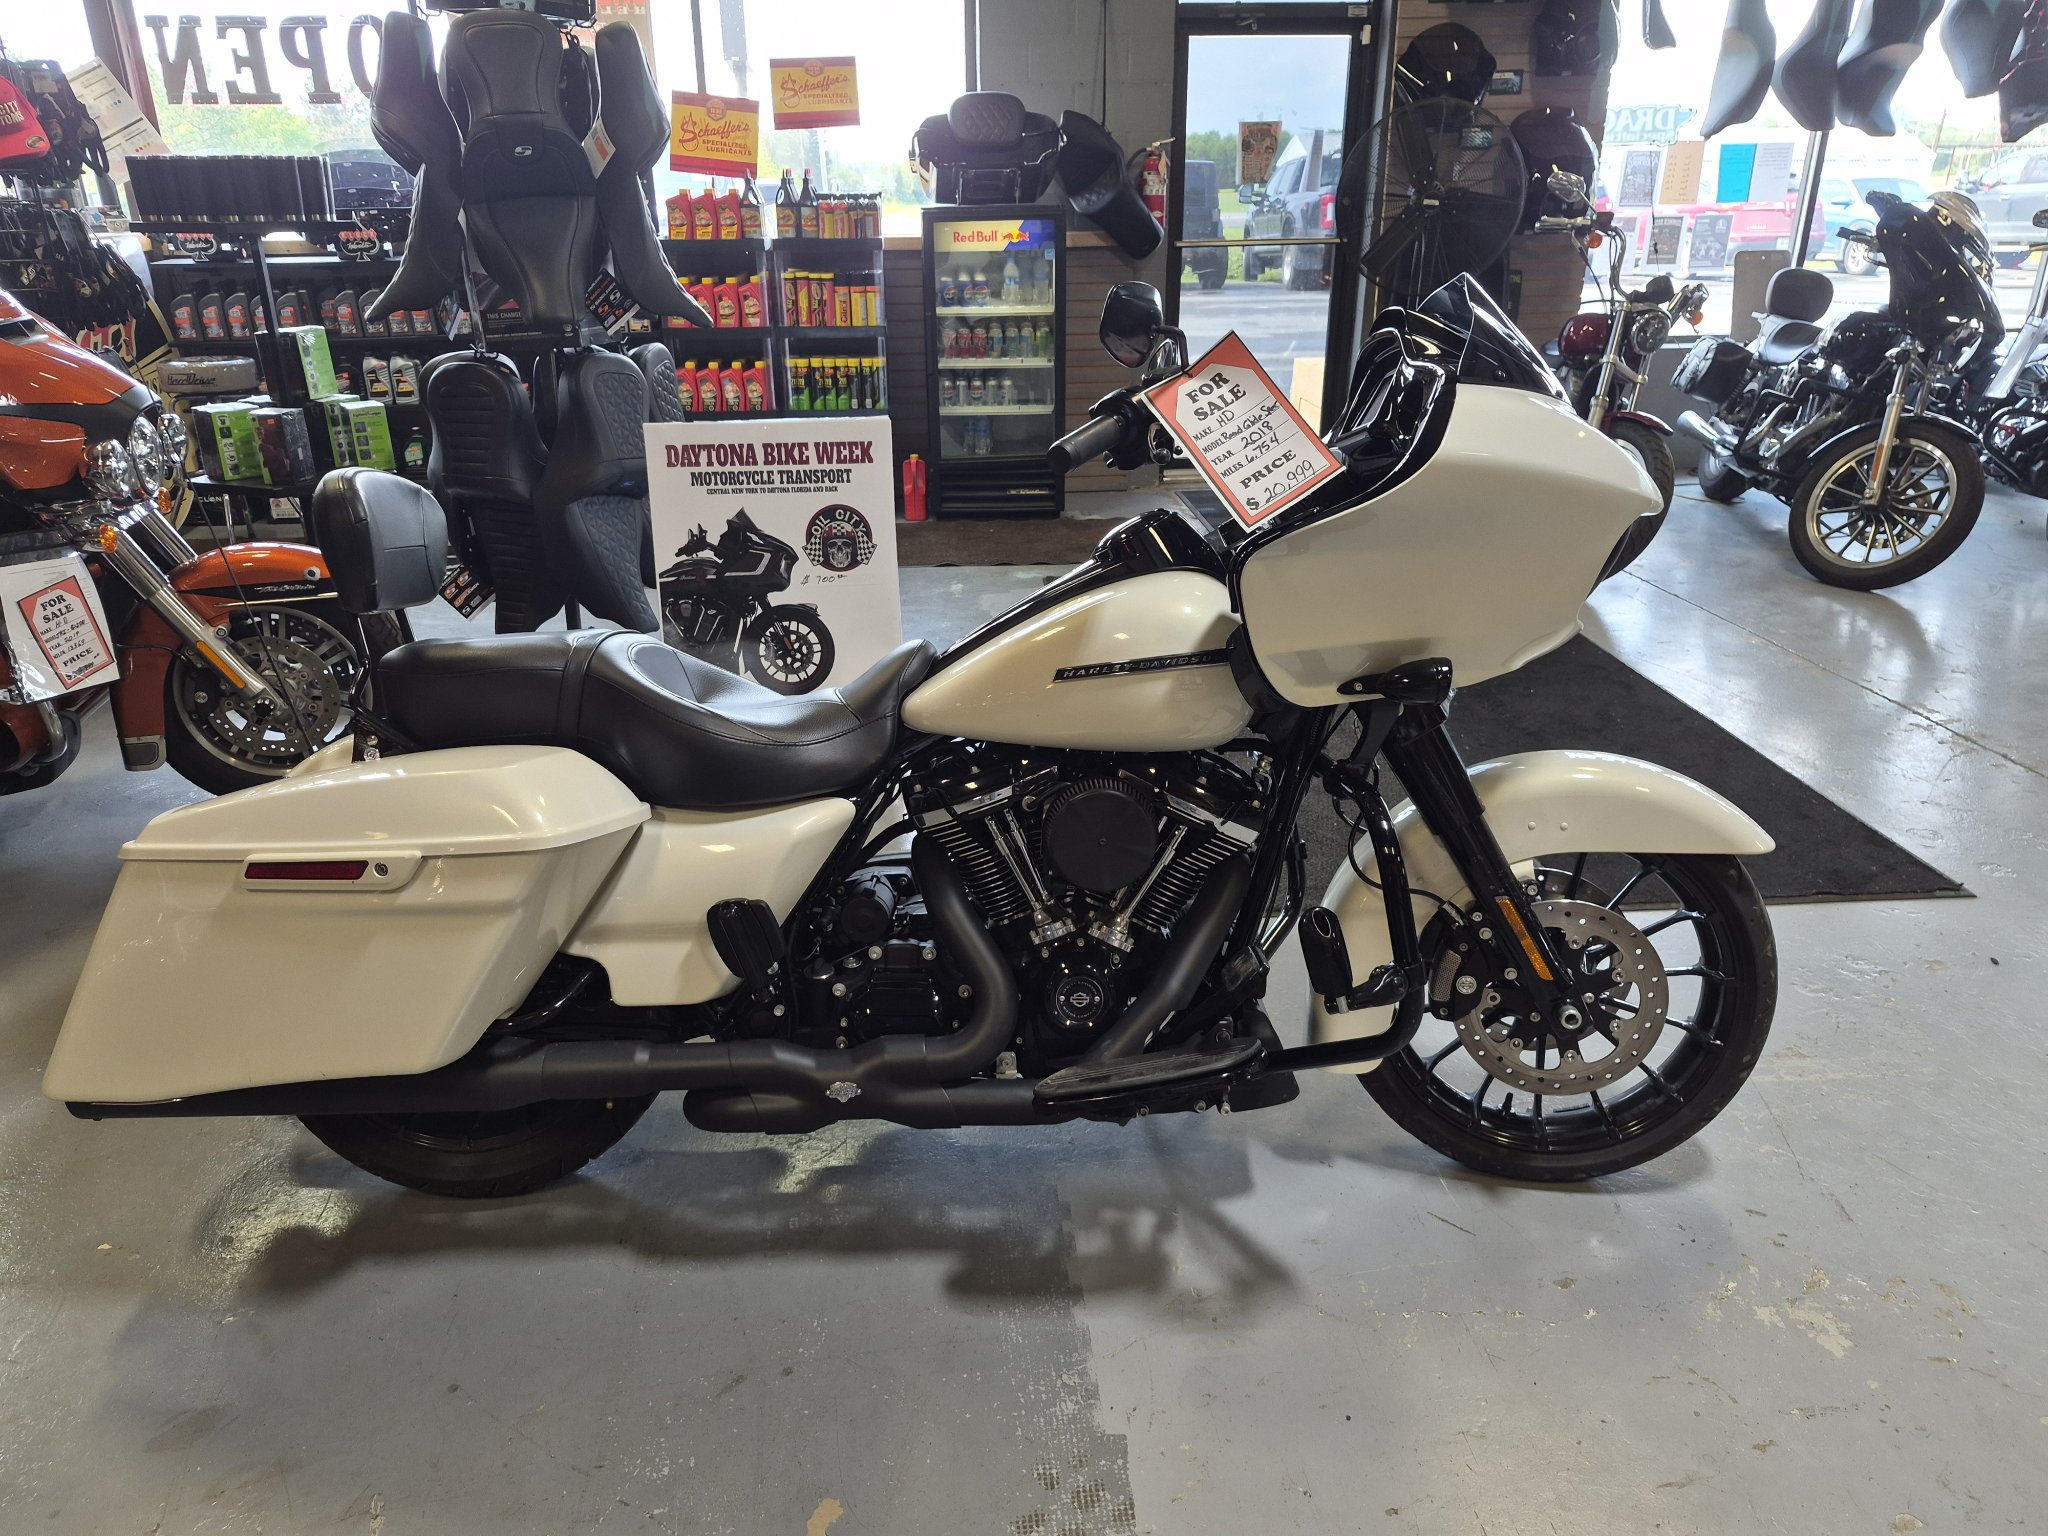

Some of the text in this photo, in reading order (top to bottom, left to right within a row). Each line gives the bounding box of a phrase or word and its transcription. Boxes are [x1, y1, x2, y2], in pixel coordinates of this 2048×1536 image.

[780, 73, 848, 101] Schaeffer's
[679, 117, 750, 144] Schaeffer's
[702, 139, 747, 149] SPECIALIZED
[706, 145, 752, 156] LUBRICANTS
[953, 230, 998, 243] Red Bull
[1185, 372, 1231, 404] FOR
[1193, 384, 1247, 421] SALE
[1192, 410, 1235, 442] MAKE HD
[665, 441, 874, 468] DAYTONA BIKE WEEK
[1202, 438, 1225, 455] MODEL
[1211, 421, 1273, 466] YEAR 2018
[690, 468, 852, 486] MOTORCYCLE TRANSPORT
[1220, 462, 1244, 479] MILES
[1240, 449, 1297, 490] PRICE
[1246, 460, 1316, 511] $ 20,999
[811, 509, 867, 535] OIL CITY
[40, 594, 66, 611] FOR
[43, 604, 74, 624] SALE
[62, 647, 93, 667] PRICE
[1063, 655, 1213, 678] HARLEY-DAVIDSO
